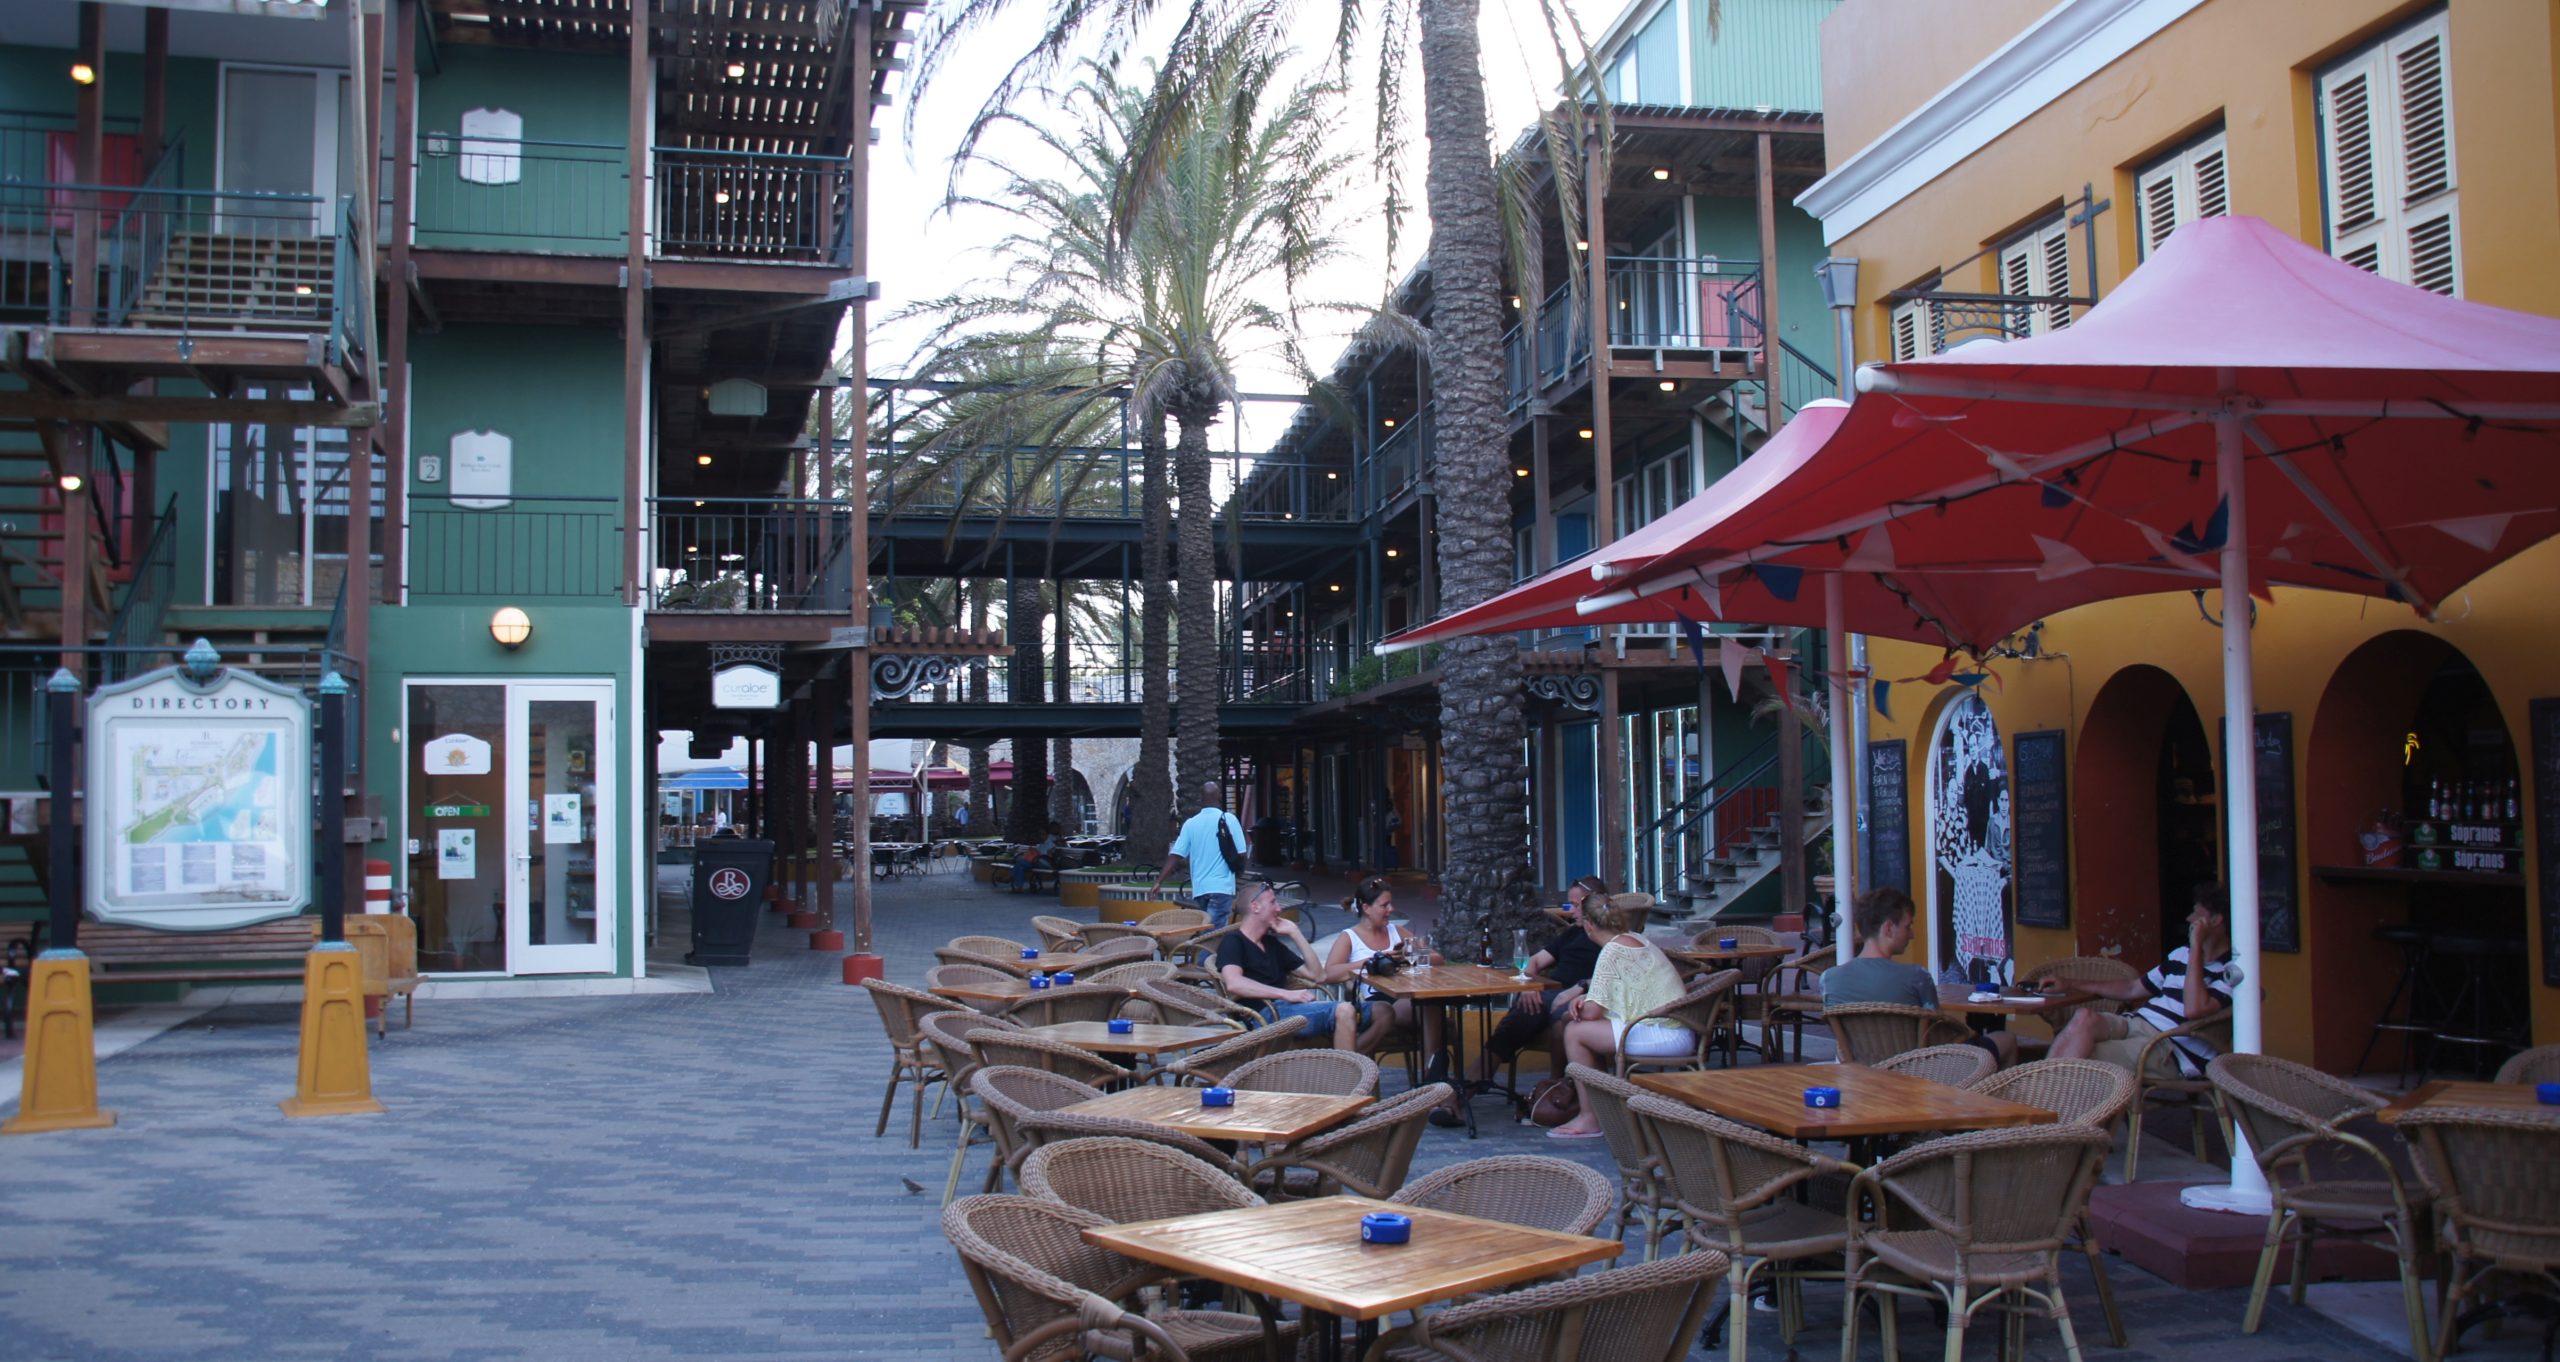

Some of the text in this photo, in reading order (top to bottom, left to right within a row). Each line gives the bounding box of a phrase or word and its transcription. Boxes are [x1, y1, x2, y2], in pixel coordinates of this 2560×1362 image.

[426, 464, 436, 479] 2
[132, 698, 270, 710] DIRECTORY
[434, 806, 460, 816] OPEN
[2451, 825, 2501, 844] Sopranos
[2454, 851, 2504, 870] Sopranos
